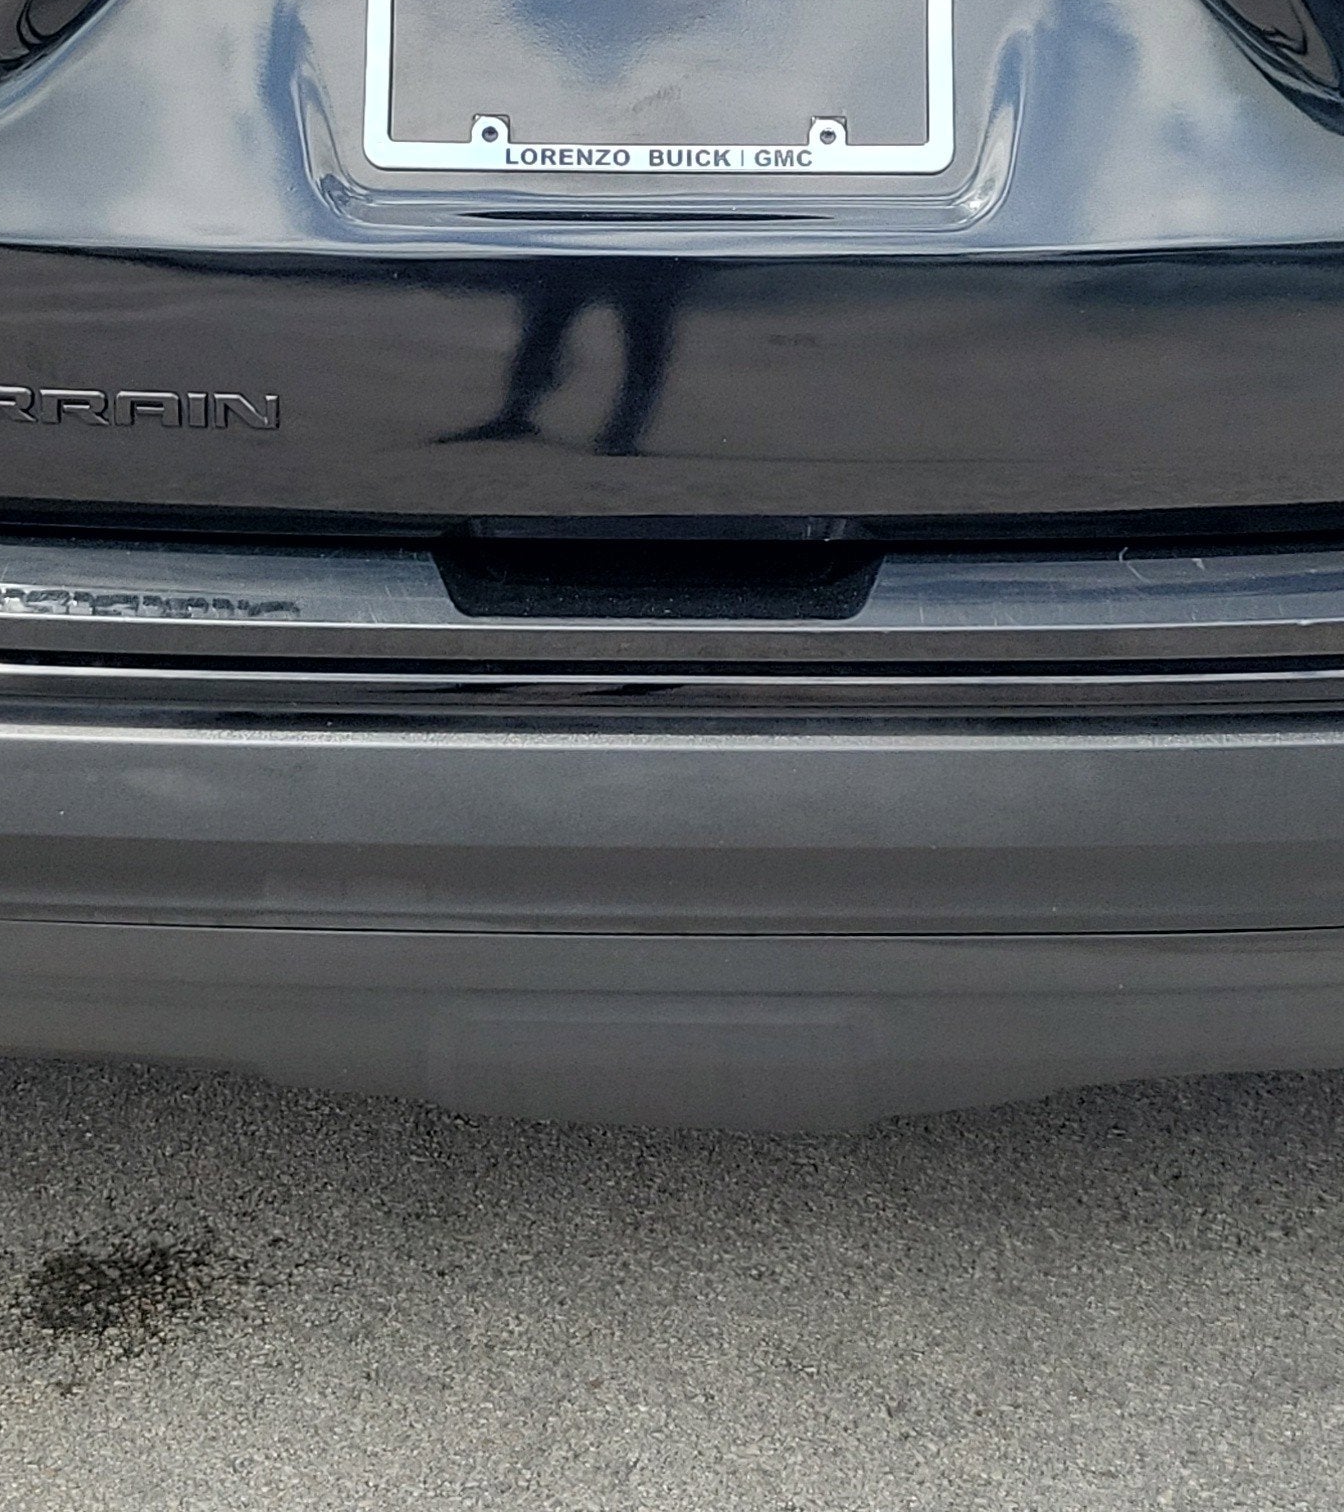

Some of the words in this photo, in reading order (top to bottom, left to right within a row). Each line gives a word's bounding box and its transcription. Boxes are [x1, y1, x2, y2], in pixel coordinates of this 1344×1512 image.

[505, 147, 631, 167] LORENZO
[648, 148, 732, 167] BUICK
[754, 149, 813, 167] GMC
